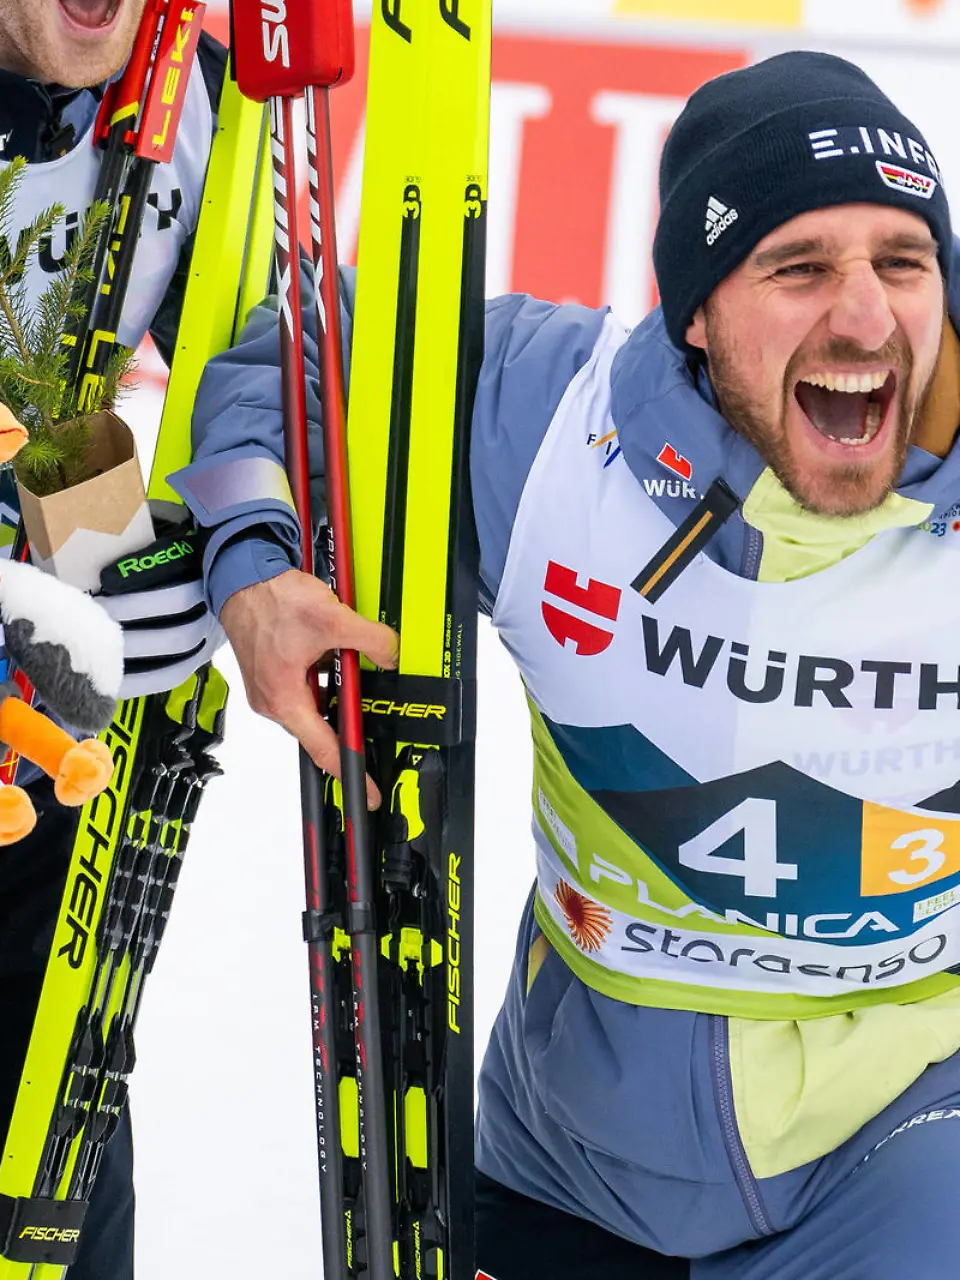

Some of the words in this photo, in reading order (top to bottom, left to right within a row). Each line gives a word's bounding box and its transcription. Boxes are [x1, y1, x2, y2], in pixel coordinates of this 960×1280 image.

[152, 7, 195, 147] LEKI
[706, 207, 739, 246] adidas
[643, 478, 704, 500] WÜR
[641, 613, 960, 710] WÜRTH
[678, 796, 798, 898] 4
[887, 828, 945, 885] 3
[590, 852, 900, 939] PLANICA
[446, 852, 462, 1035] FISCHER
[621, 921, 948, 985] storaenso
[315, 1045, 327, 1173] TECHNOLOGY
[19, 1226, 81, 1242] FISCHER
